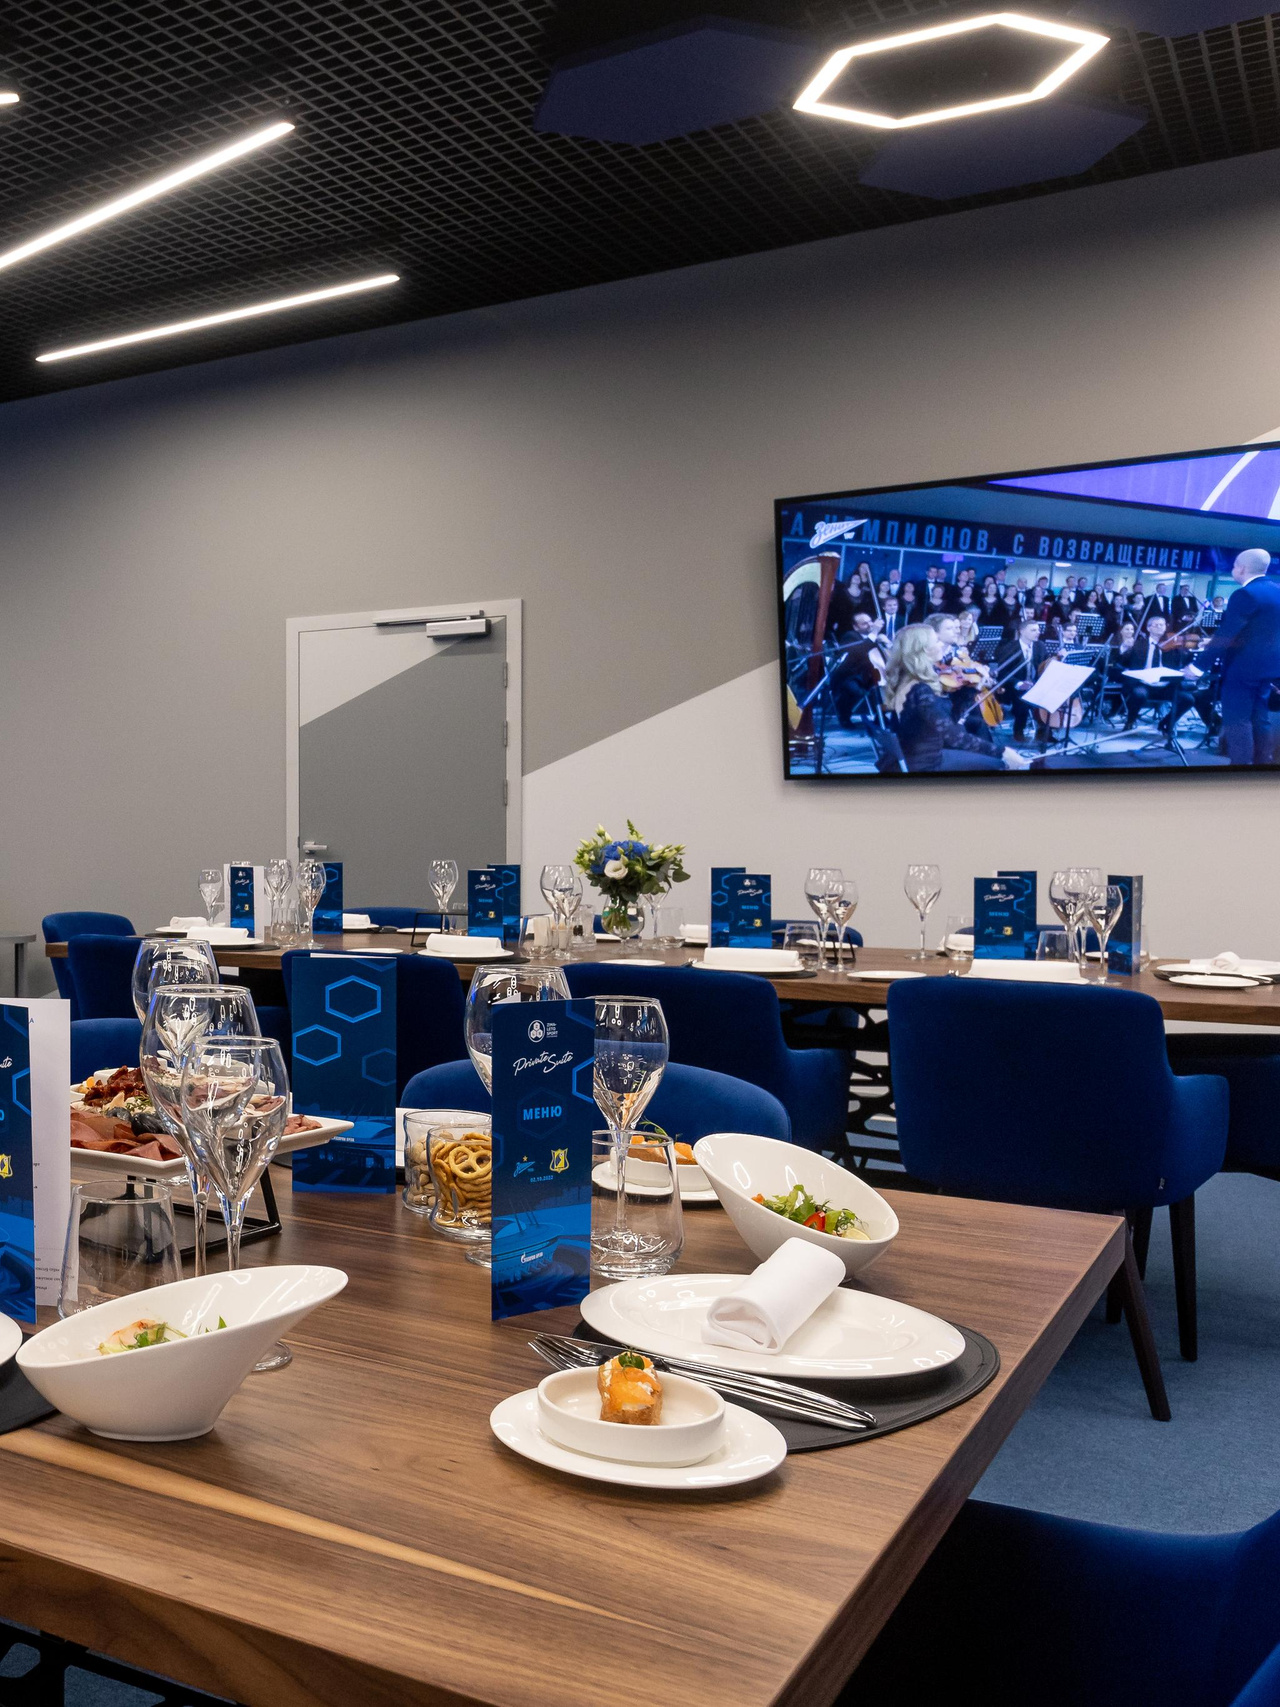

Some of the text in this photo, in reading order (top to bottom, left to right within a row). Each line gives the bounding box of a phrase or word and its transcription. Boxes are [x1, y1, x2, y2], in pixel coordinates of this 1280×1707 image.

[823, 513, 998, 556] МПИОНОВ,
[1038, 535, 1202, 570] ВОЗВРАЩЕНИЕМ!
[512, 1050, 574, 1076] Private Suite
[523, 1105, 562, 1121] МЕНЮ
